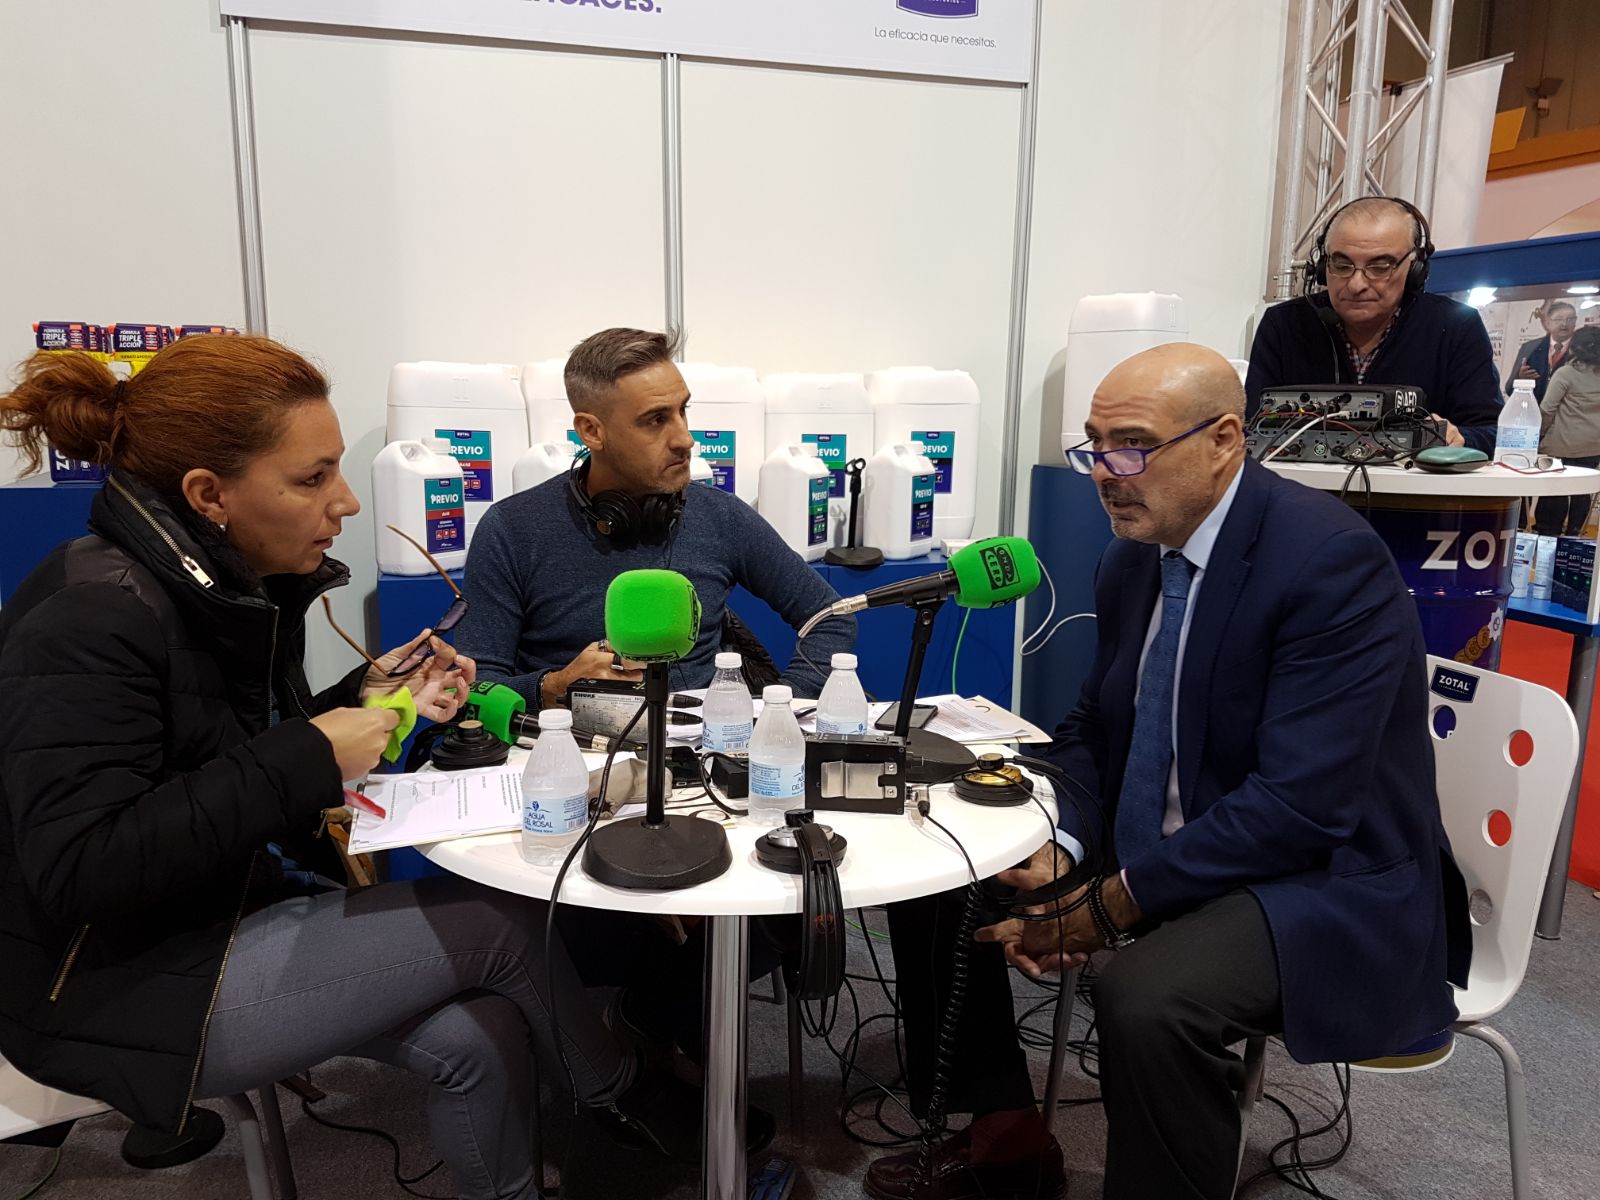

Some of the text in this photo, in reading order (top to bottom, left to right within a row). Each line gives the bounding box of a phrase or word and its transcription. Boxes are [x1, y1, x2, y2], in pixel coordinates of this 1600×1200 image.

[874, 26, 997, 48] La eficacia que necesitas.
[42, 333, 67, 341] TRIPLE
[119, 334, 141, 342] TRIPLE
[119, 340, 141, 348] ACCIÓN
[451, 446, 483, 455] REVIO
[701, 445, 729, 454] REVIO
[923, 445, 948, 453] REVIO
[430, 494, 459, 504] PREVIO
[987, 554, 1002, 583] CERO
[998, 549, 1013, 579] ONDA
[1438, 674, 1470, 691] ZOTAL
[528, 812, 546, 820] AGUA
[532, 820, 553, 829] ROSAL
